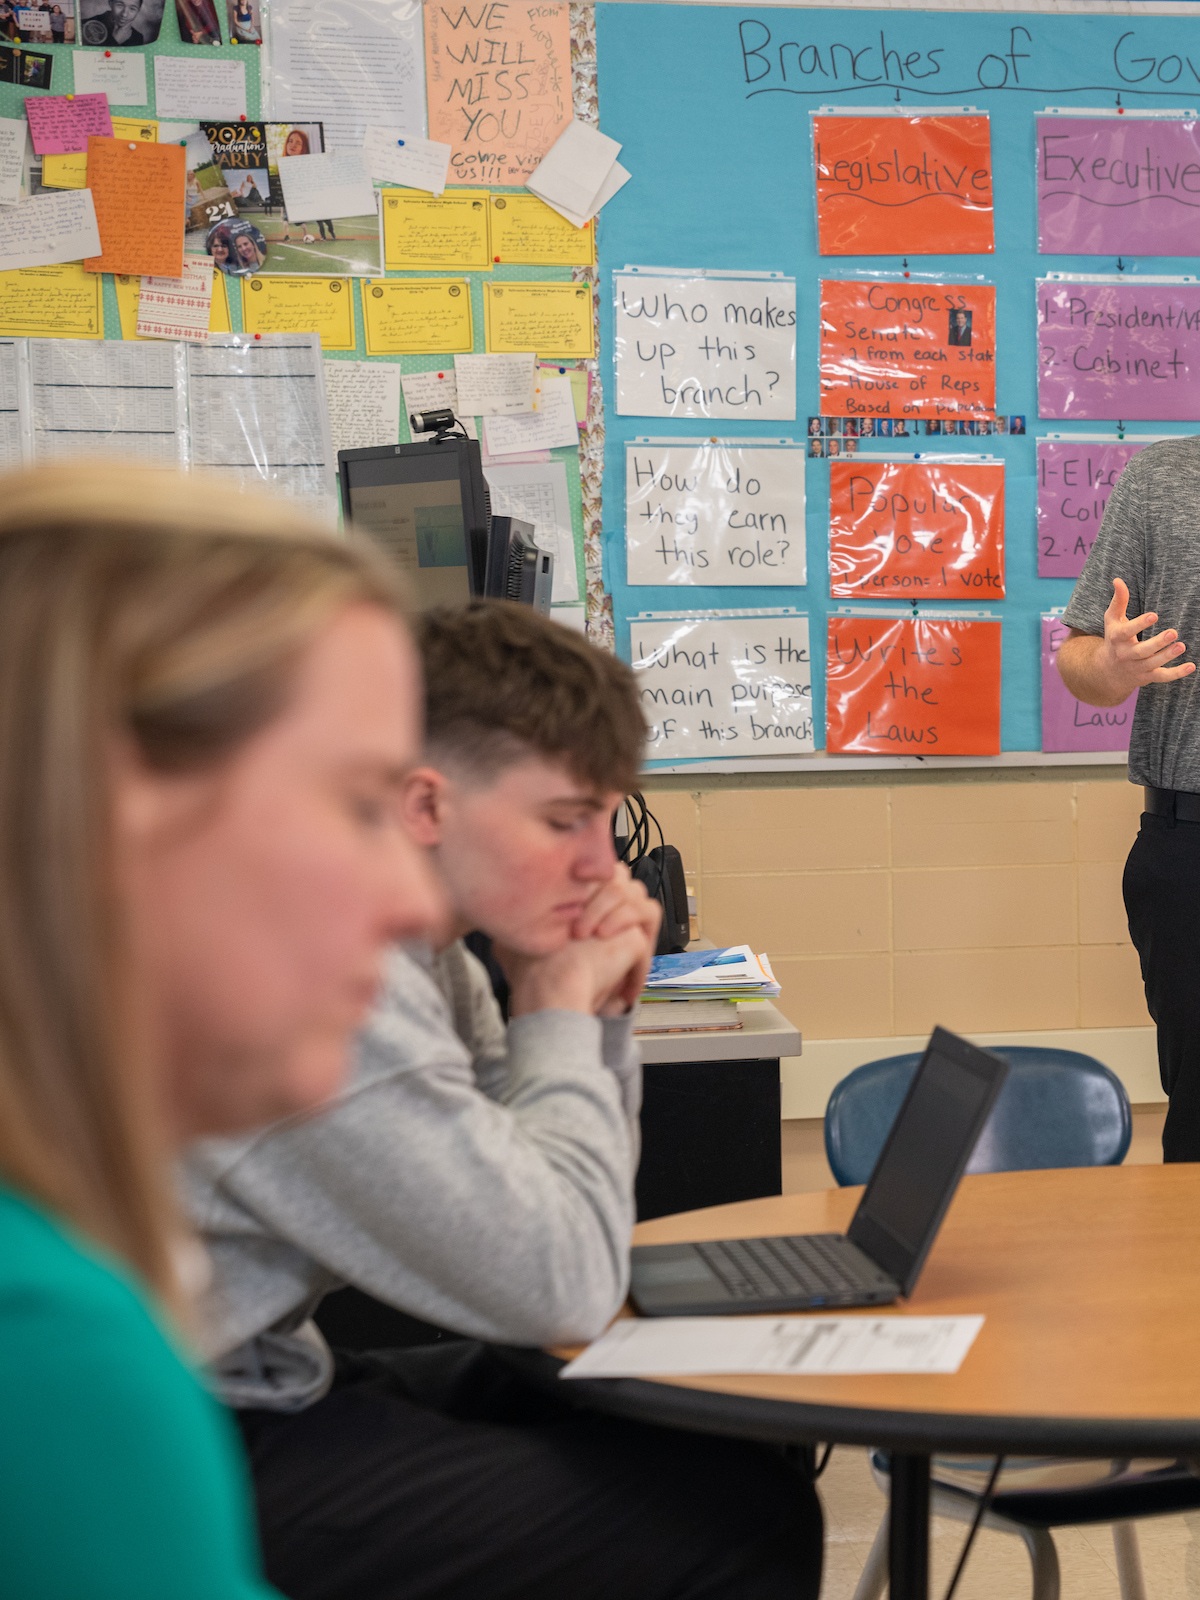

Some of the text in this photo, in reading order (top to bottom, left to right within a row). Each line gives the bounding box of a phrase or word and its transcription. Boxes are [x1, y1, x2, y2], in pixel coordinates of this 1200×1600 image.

[441, 3, 509, 30] WE
[446, 38, 535, 65] WILL
[739, 20, 944, 83] Branches
[978, 27, 1031, 89] of
[447, 71, 530, 105] MISS
[208, 126, 262, 145] 2023
[461, 106, 521, 142] YOU
[515, 153, 544, 167] visi
[817, 143, 989, 191] Legislative
[622, 290, 796, 328] Who makes
[868, 285, 968, 323] Congress
[845, 321, 920, 341] Senate
[637, 335, 756, 370] up this
[867, 346, 905, 361] from
[914, 349, 948, 361] each
[661, 371, 780, 406] branch?
[849, 374, 900, 392] House
[909, 375, 928, 392] of
[941, 374, 981, 396] Reps
[845, 398, 891, 414] Based
[903, 404, 920, 415] on
[634, 456, 761, 496] How do
[1064, 458, 1127, 487] Elec
[850, 476, 971, 520] Popular
[1061, 498, 1106, 521] Coll
[639, 500, 787, 535] they earn
[655, 535, 791, 568] this role?
[960, 568, 1002, 588] vote
[638, 636, 810, 669] What is the
[834, 634, 963, 666] Writes
[641, 684, 714, 708] main
[884, 671, 939, 705] the
[698, 719, 739, 741] this
[750, 715, 813, 742] branch?
[867, 711, 939, 744] Laws
